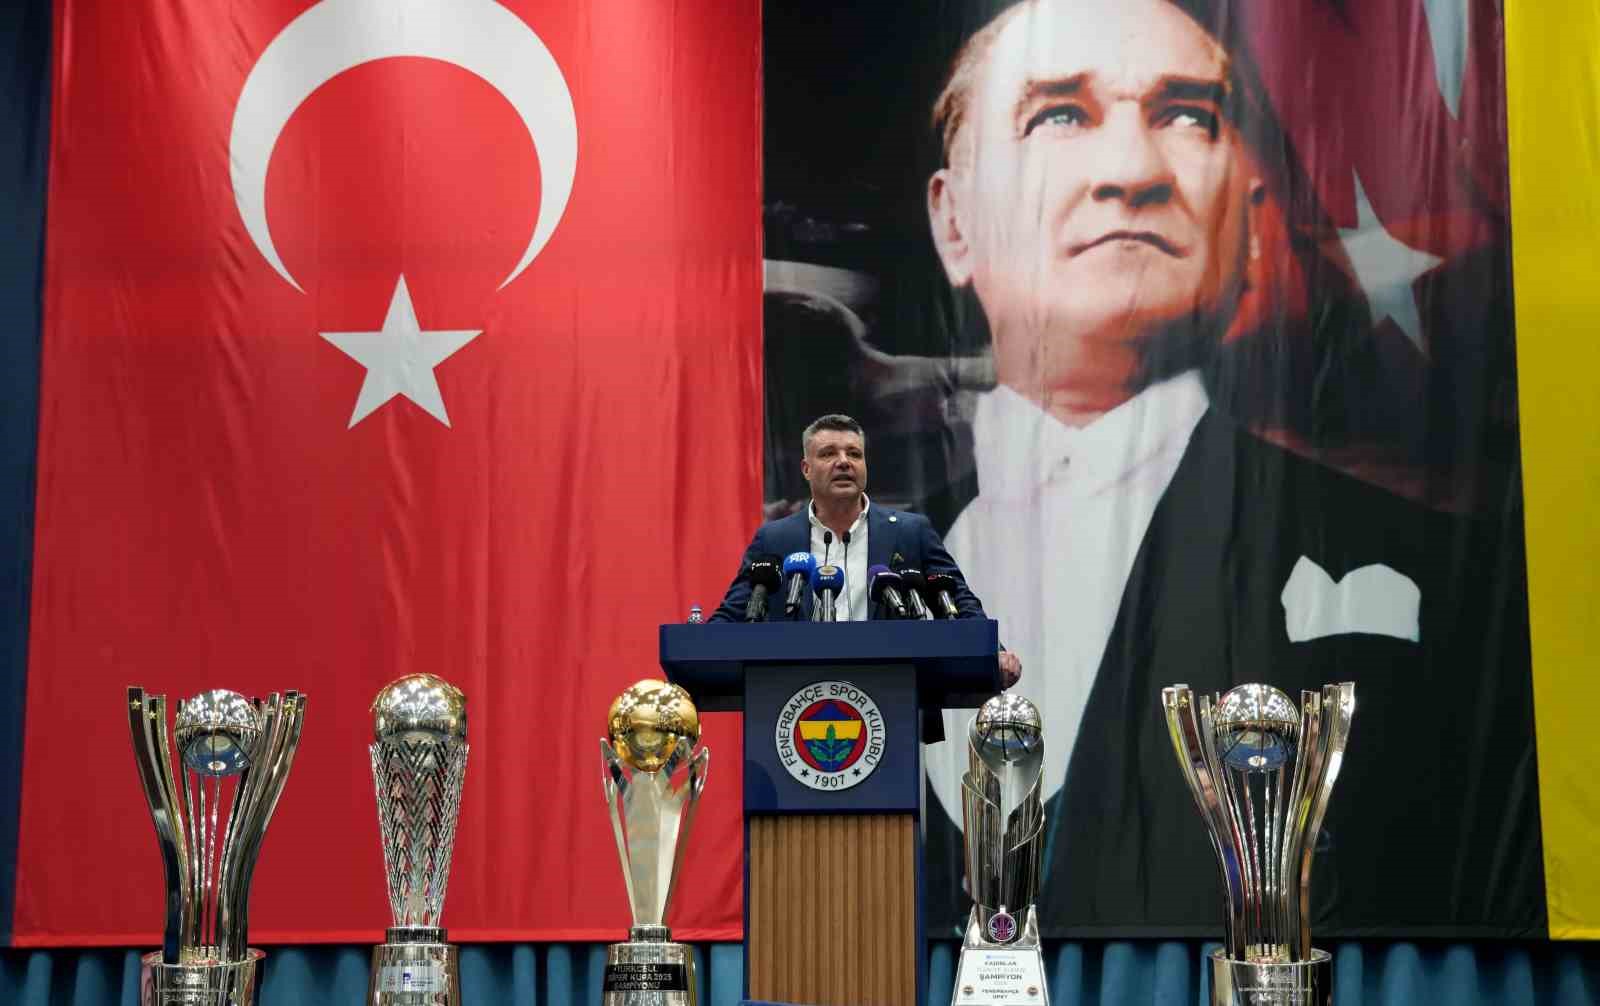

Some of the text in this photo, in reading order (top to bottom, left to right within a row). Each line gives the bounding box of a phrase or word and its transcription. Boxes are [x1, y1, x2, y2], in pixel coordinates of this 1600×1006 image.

[779, 684, 885, 767] FENERBAHÇE SPOR KULÜBÜ
[814, 774, 846, 788] 1907
[630, 973, 653, 981] KUPA
